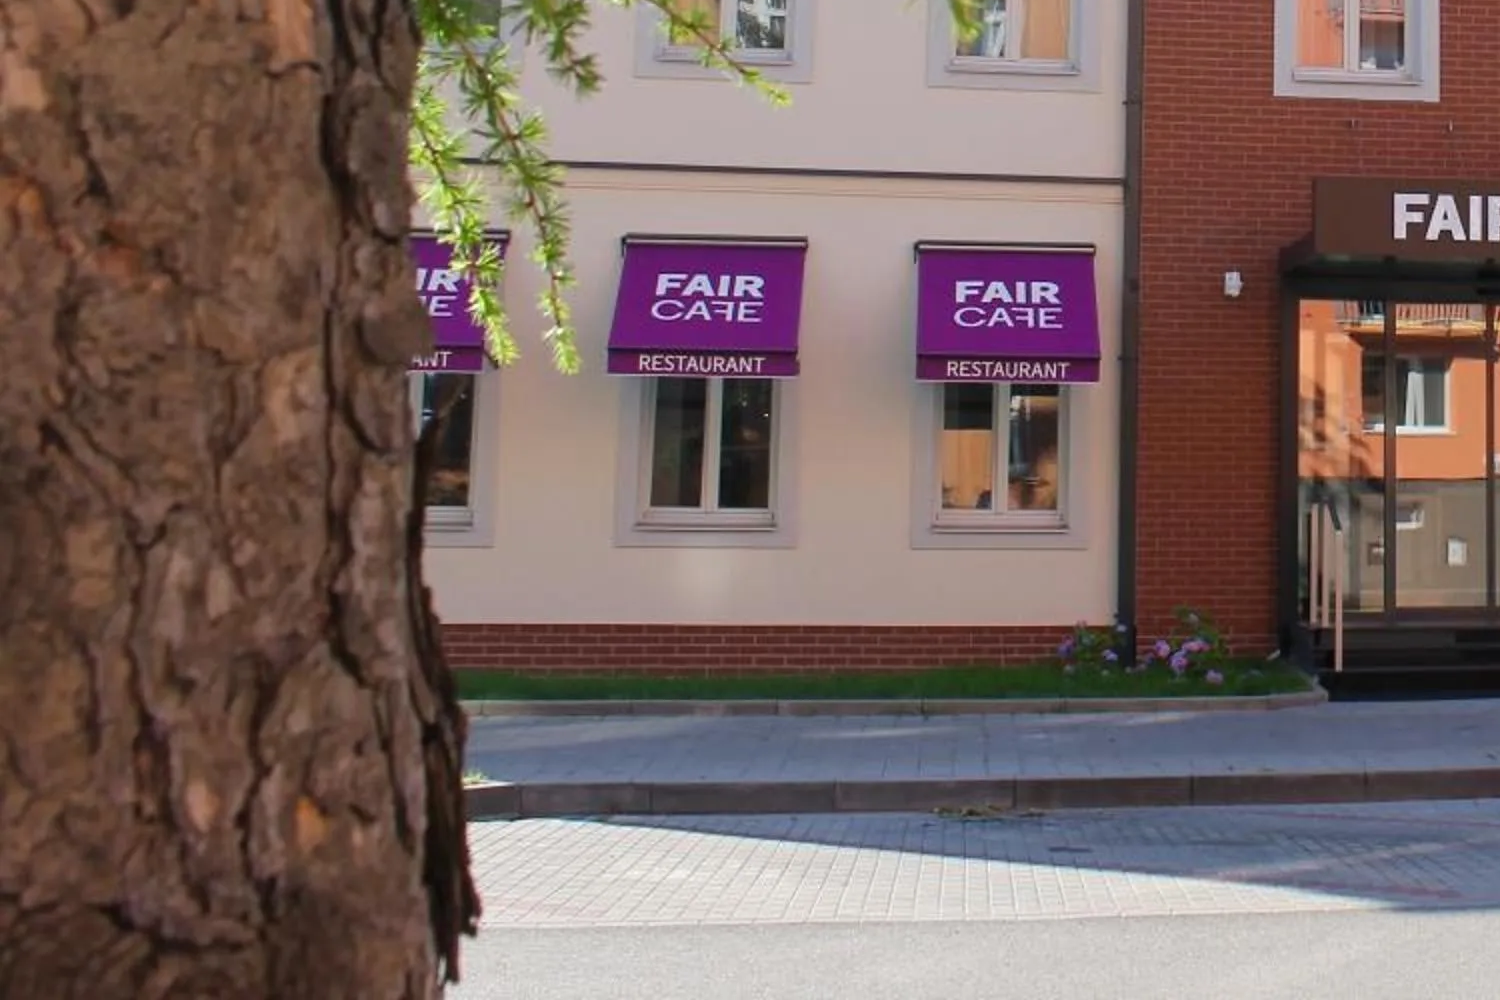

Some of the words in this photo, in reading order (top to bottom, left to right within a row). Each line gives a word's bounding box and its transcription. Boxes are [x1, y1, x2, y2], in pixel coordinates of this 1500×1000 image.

[655, 272, 765, 298] FAIR
[955, 280, 1062, 305] FAIR
[651, 299, 764, 323] CAFE
[953, 307, 1063, 329] CAFE
[638, 354, 766, 374] RESTAURANT
[946, 360, 1071, 379] RESTAURANT
